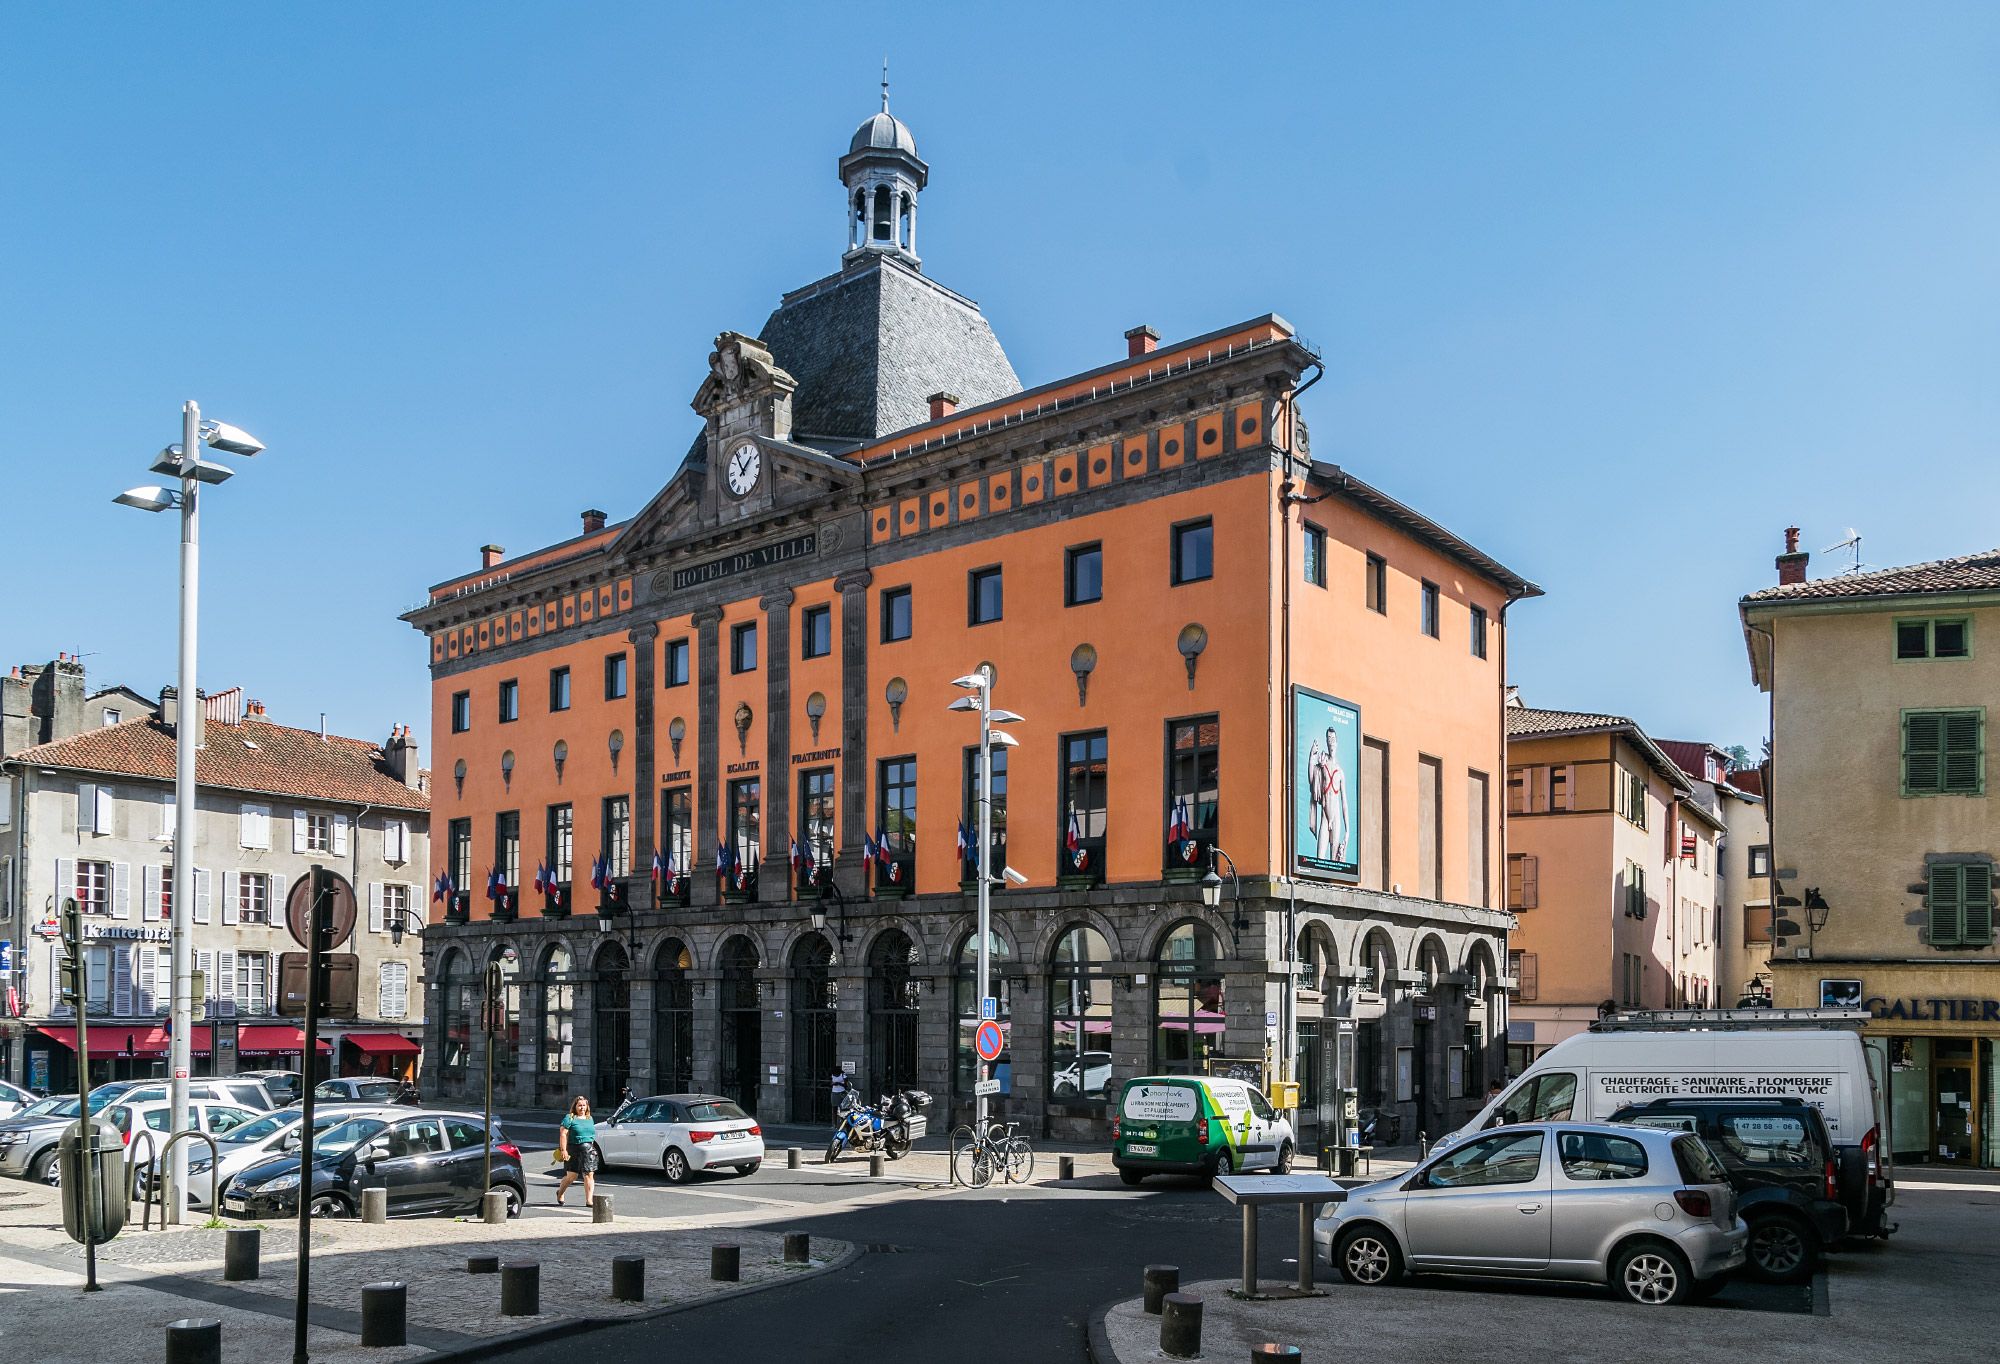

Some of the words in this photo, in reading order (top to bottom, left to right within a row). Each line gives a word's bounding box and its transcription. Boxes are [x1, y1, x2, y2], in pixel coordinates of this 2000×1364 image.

[677, 561, 728, 588] HOTEL
[734, 553, 755, 572] DE
[761, 537, 813, 563] VILLE
[791, 748, 841, 765] FRATERNITE
[727, 761, 760, 774] EGALITE
[662, 770, 692, 783] LIBERTE
[86, 924, 171, 941] Kanterbrä
[1863, 998, 2000, 1022] GALTIER
[1600, 1077, 1671, 1086] CHAUFFAGE
[1681, 1077, 1746, 1086] SANITAIRE
[1757, 1077, 1833, 1086] PLOMBERIE
[1605, 1085, 1679, 1094] ELECTRICITE
[1690, 1086, 1786, 1094] CLIMATISATION
[1798, 1086, 1828, 1095] VMC
